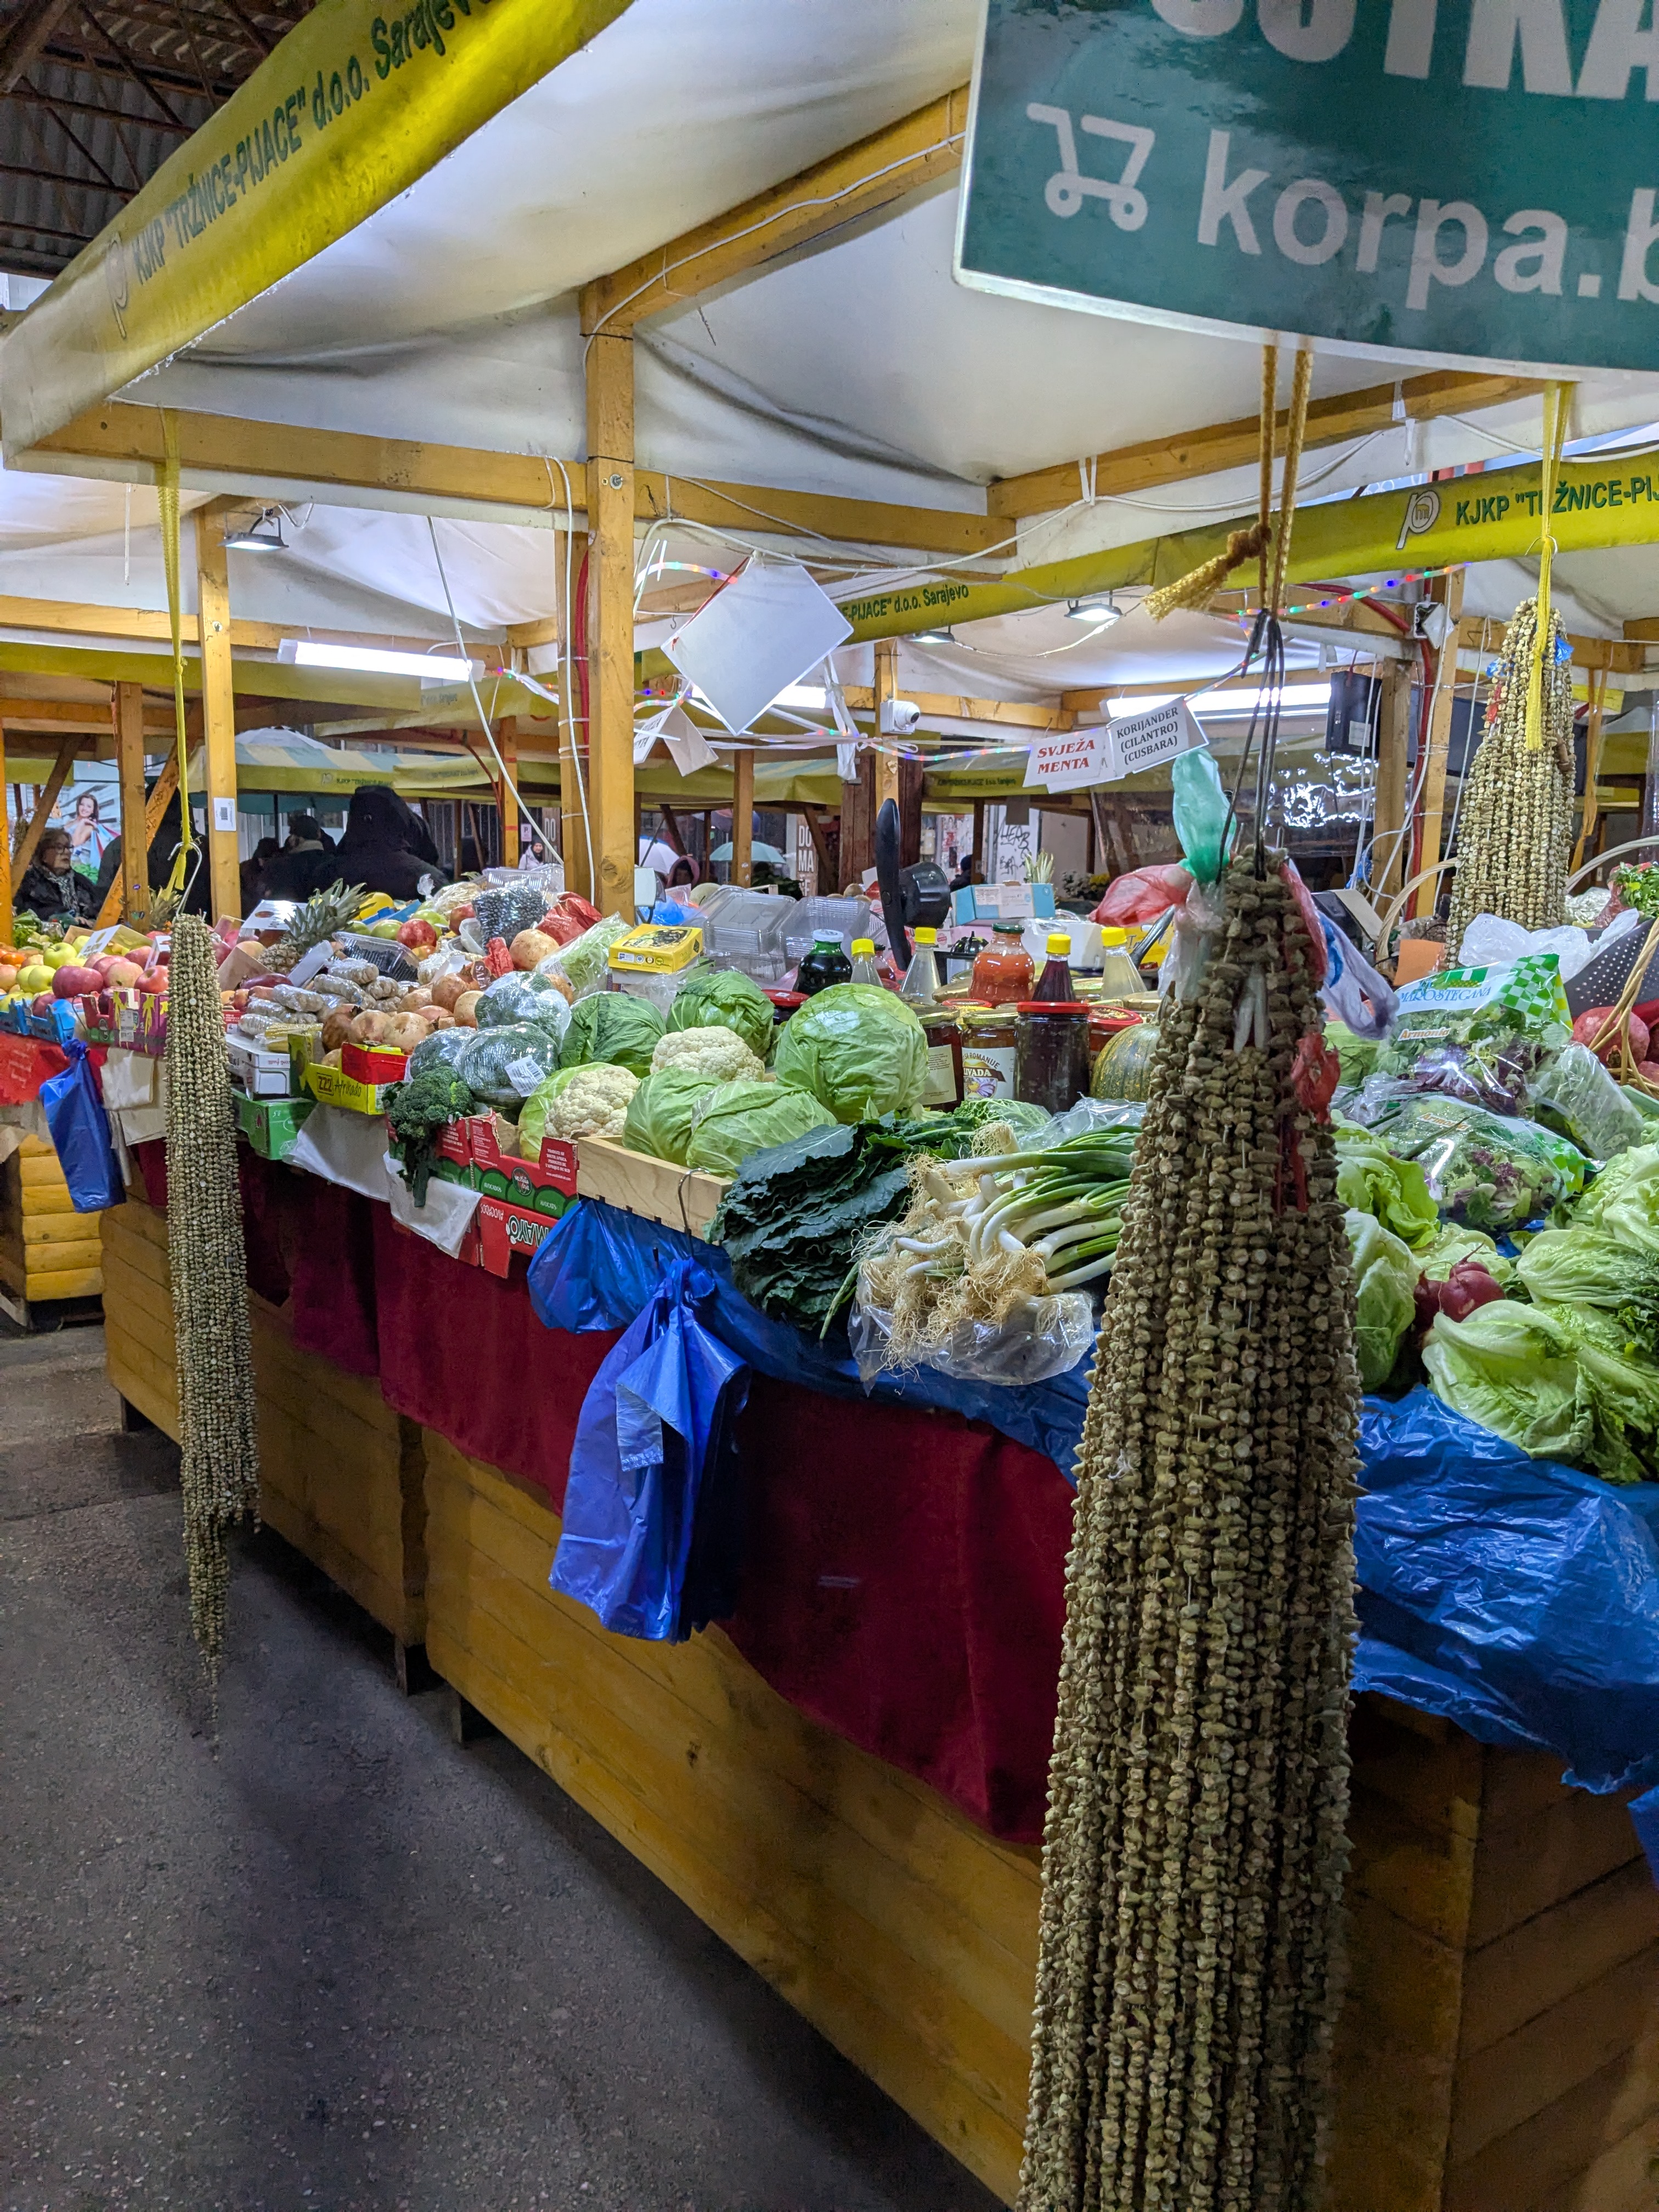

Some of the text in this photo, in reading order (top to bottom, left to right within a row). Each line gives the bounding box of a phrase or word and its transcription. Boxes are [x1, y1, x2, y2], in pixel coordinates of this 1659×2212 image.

[312, 55, 371, 131] d.o.o.
[371, 0, 490, 80] Saraje
[1455, 495, 1510, 526] KJKP
[894, 595, 921, 613] d.o.o.
[923, 584, 969, 606] Sarajevo
[1116, 707, 1179, 740] KORIJANDER
[1037, 737, 1096, 759] SVJEŽA
[1120, 721, 1178, 753] (CILANTRO)
[1125, 735, 1177, 765] (CUSBARA)
[1037, 757, 1090, 774] MENTA
[798, 825, 812, 848] DO
[798, 849, 815, 872] MA
[1400, 1028, 1451, 1039] Armonia
[969, 1052, 1000, 1069] ROMANIJE
[480, 1203, 504, 1221] AVOCADOS
